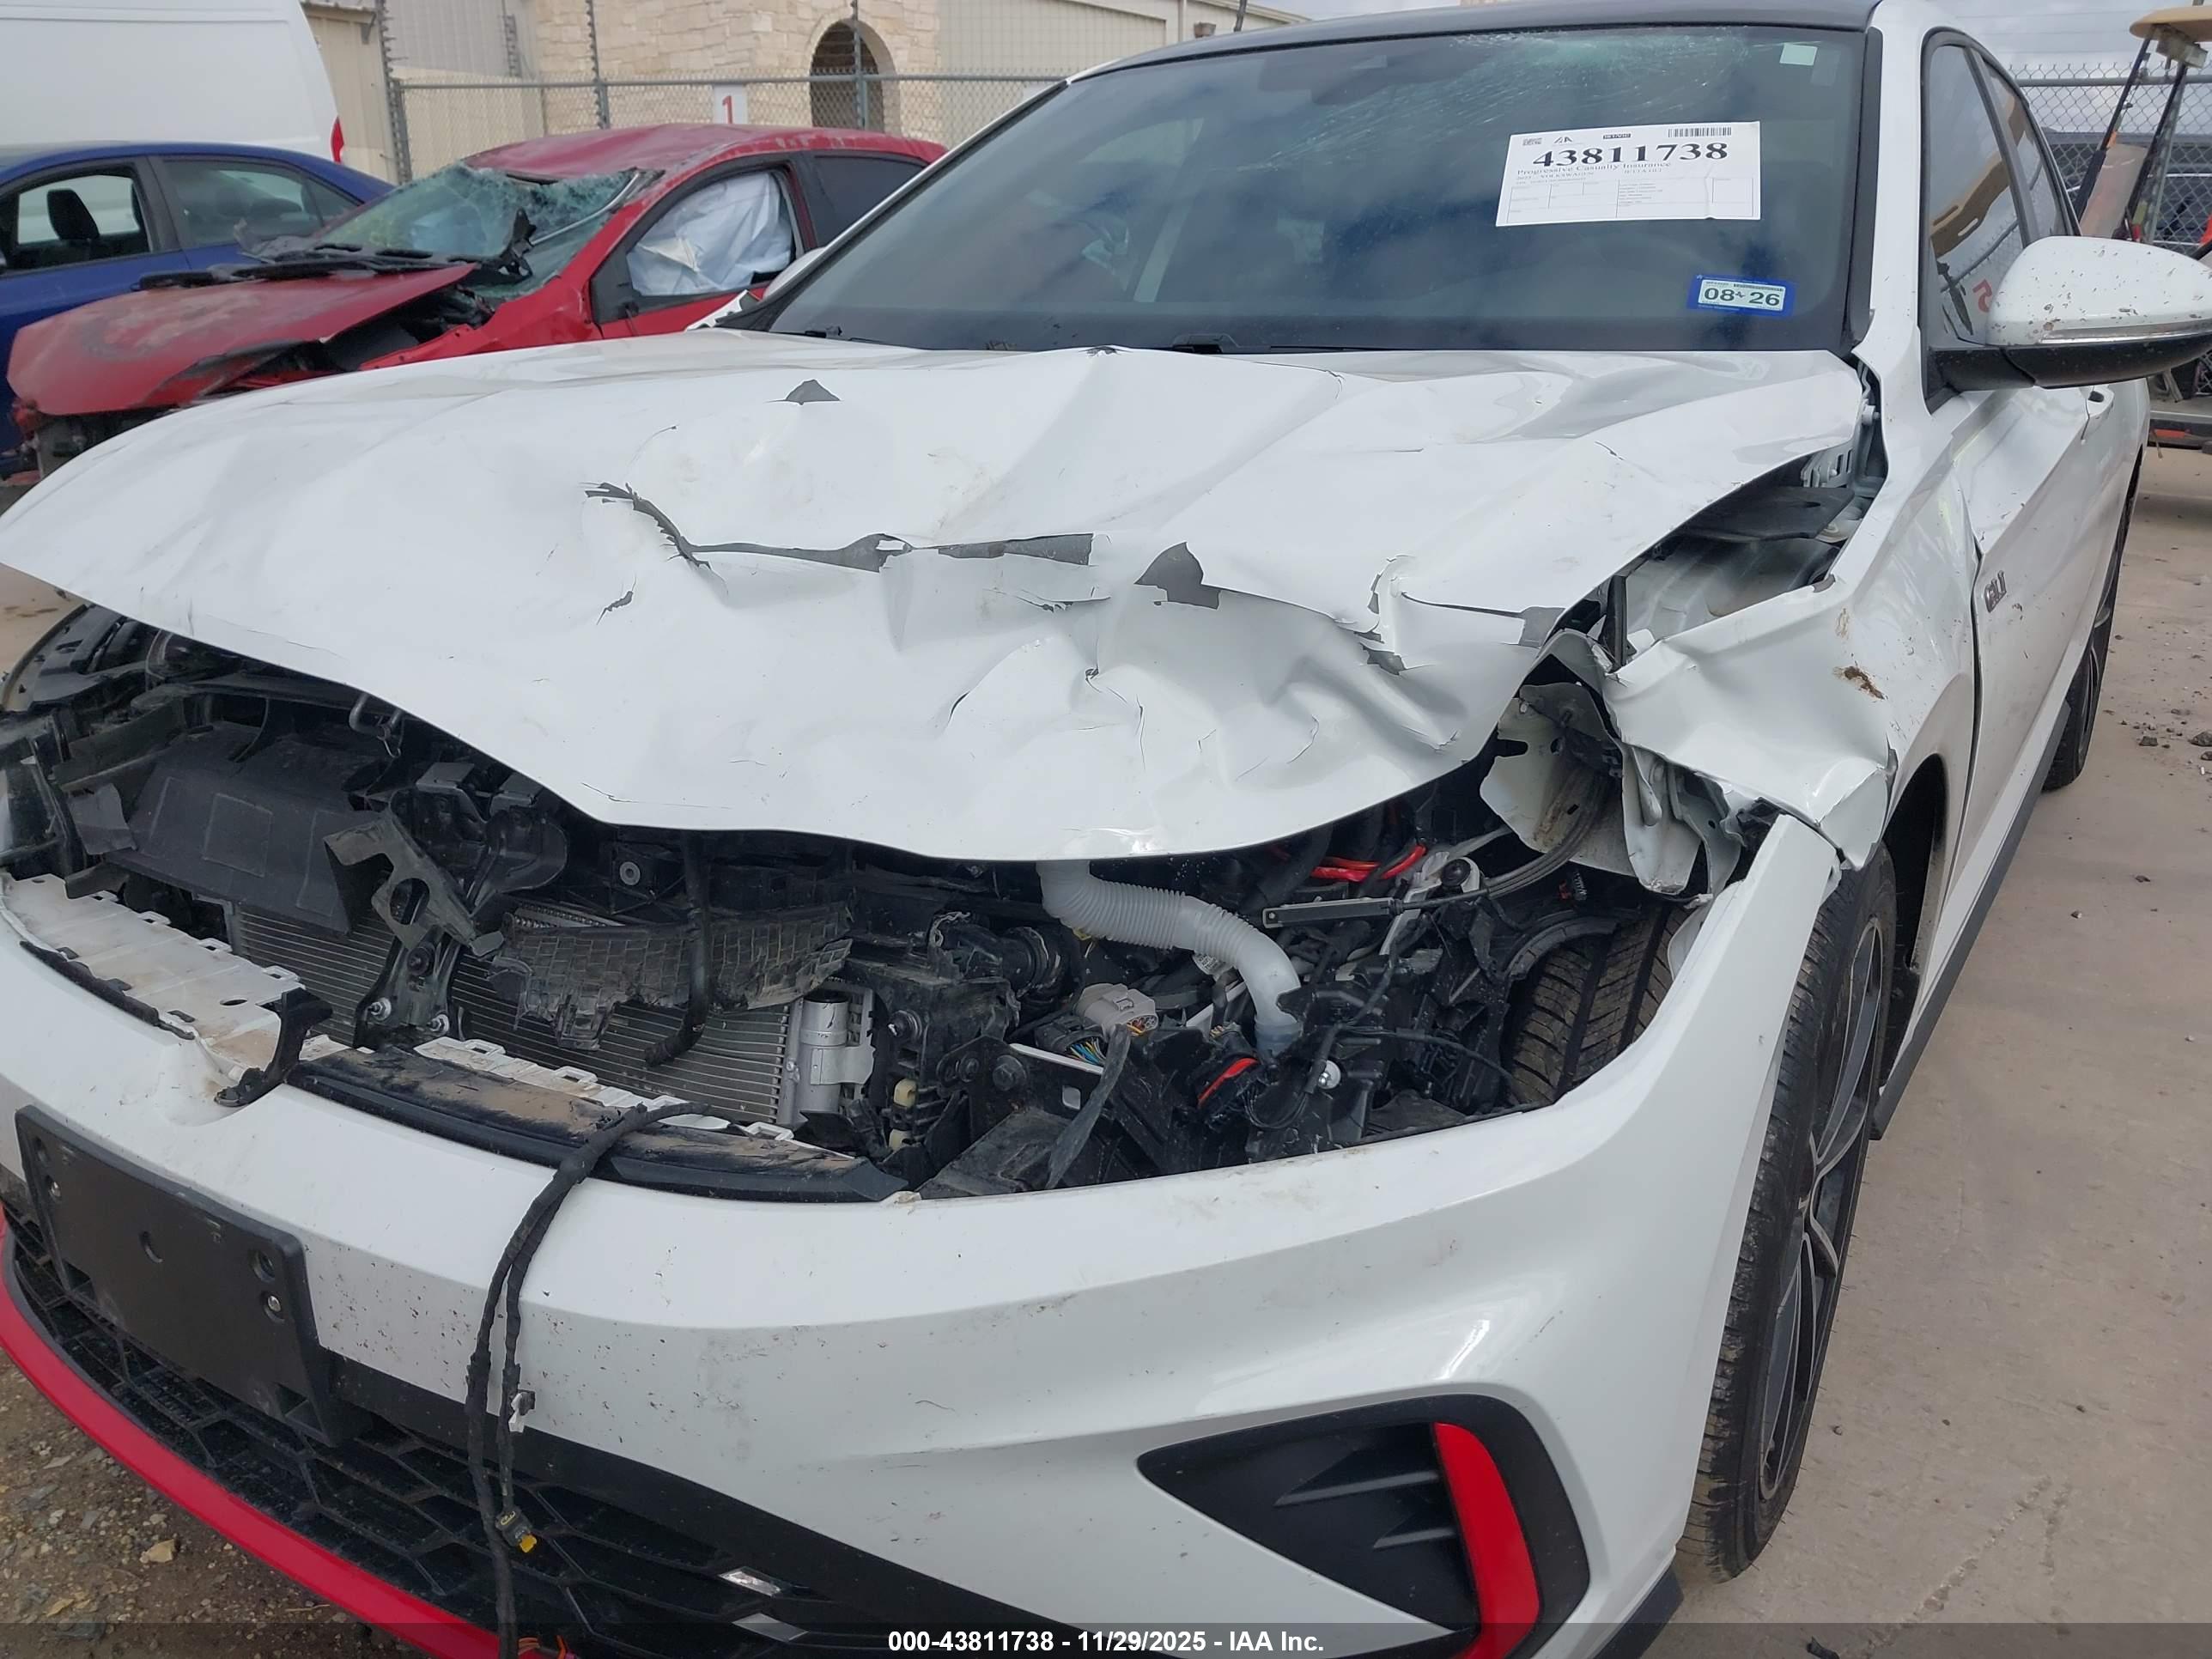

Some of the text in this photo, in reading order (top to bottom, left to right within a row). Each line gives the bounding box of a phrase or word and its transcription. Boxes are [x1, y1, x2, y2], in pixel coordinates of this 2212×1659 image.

[722, 94, 732, 124] 1
[1533, 142, 1728, 167] 43811738
[1705, 288, 1780, 307] 08 26
